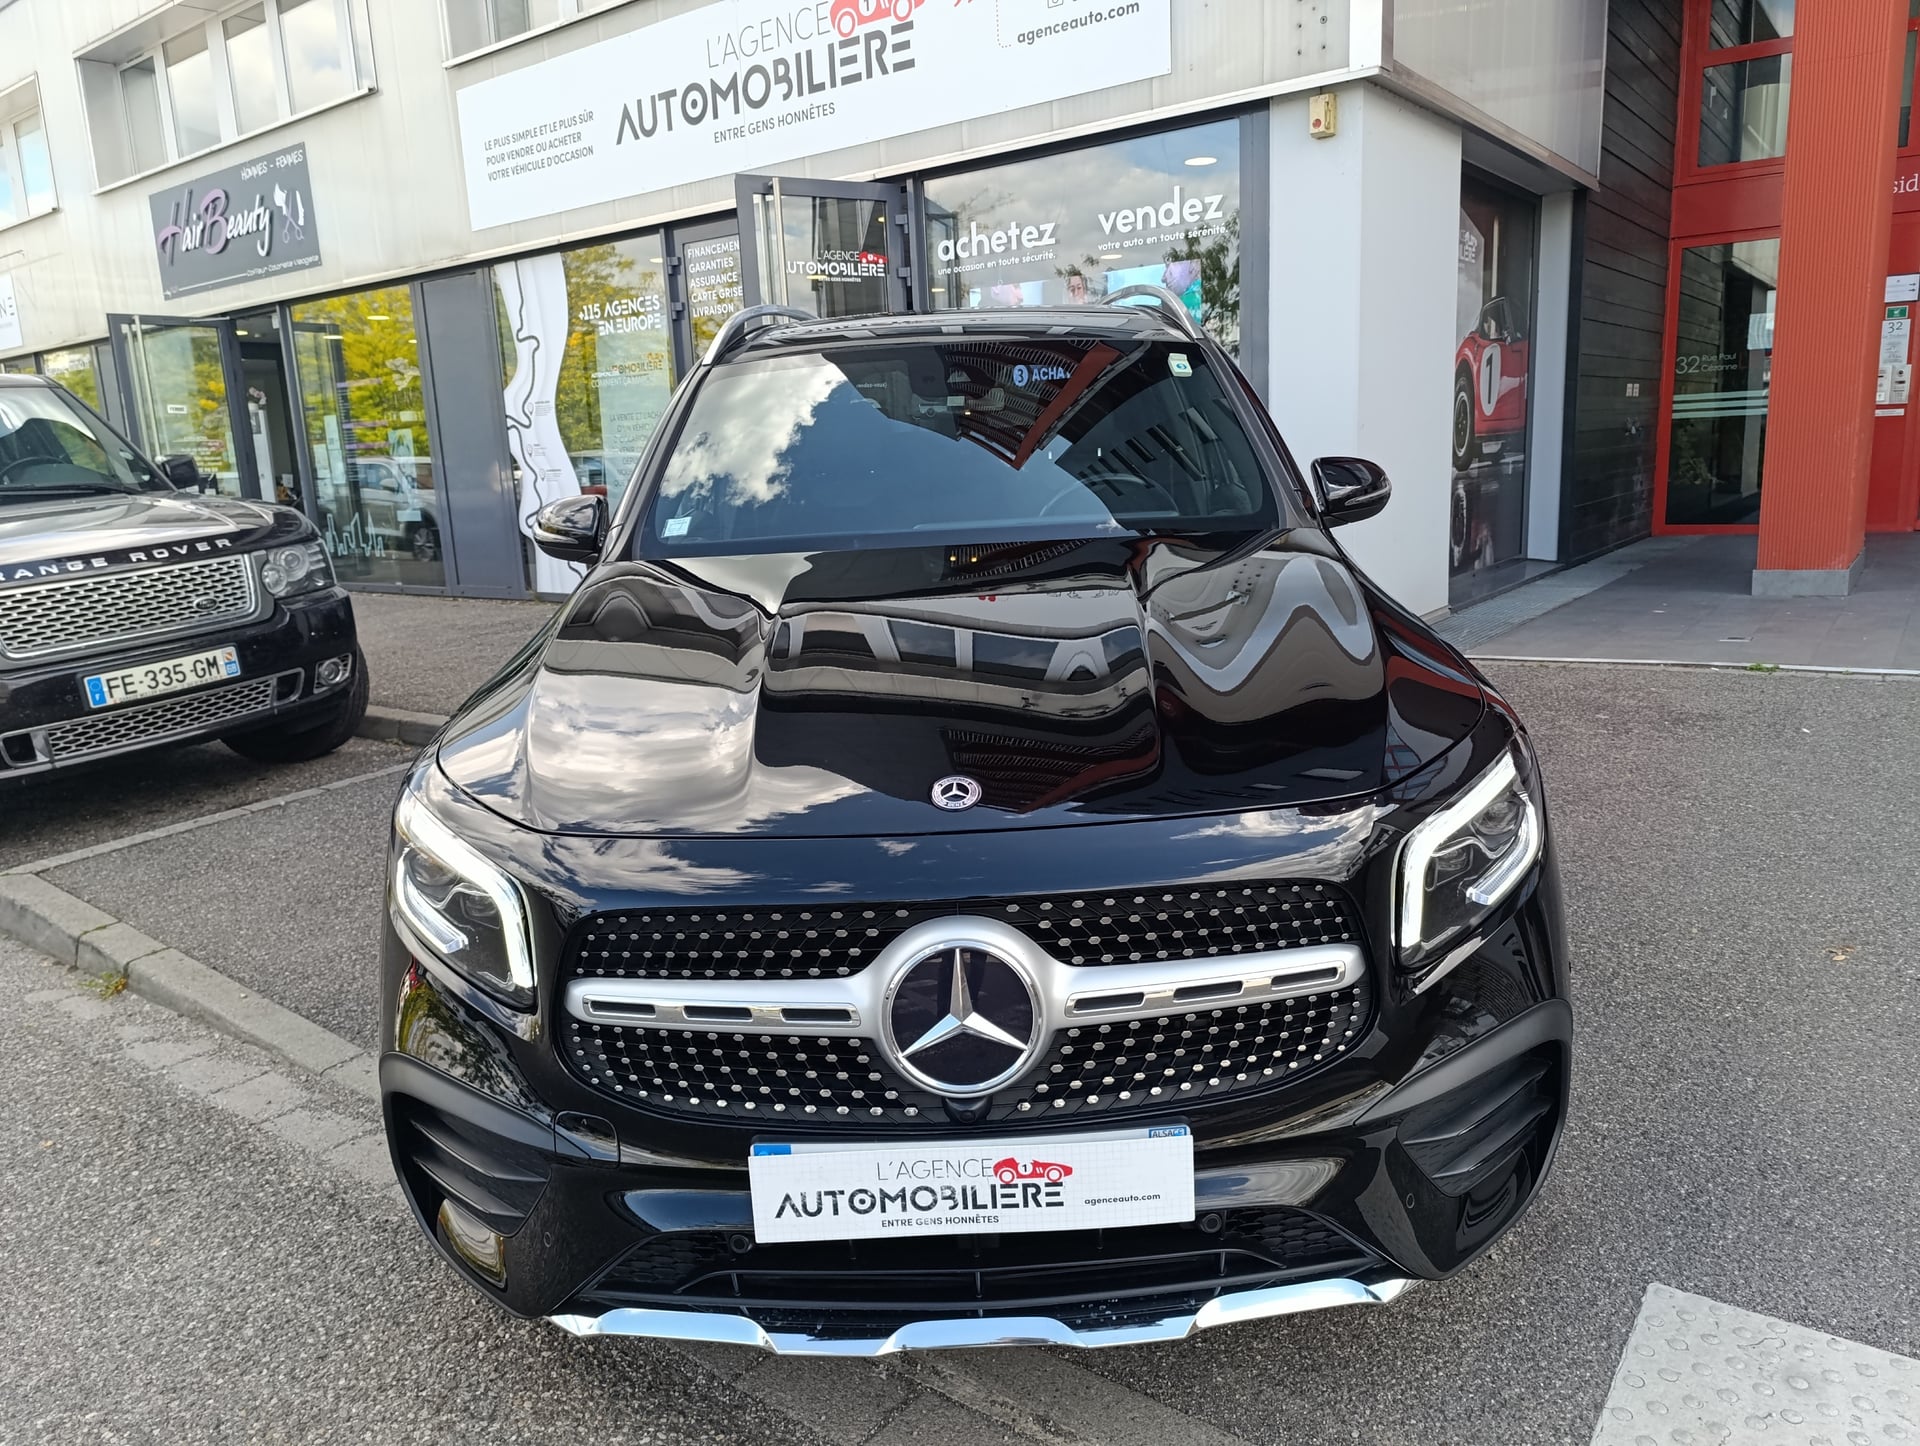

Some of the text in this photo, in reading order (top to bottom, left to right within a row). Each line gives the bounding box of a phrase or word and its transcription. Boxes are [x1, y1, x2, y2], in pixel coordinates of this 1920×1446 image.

[706, 1, 831, 68] L'AGENCE
[1017, 2, 1140, 45] agenceauto.com
[484, 109, 594, 152] LE PLUS SIMPLE ET LE PLUS SÛR
[713, 102, 836, 144] ENTRE GENS HONNÊTES
[486, 131, 582, 166] POUR VENDRE OU ACHETER
[488, 145, 594, 182] VOTRE VÉHICULE D'OCCASION
[1098, 185, 1224, 235] vendez
[937, 221, 1056, 262] achetez
[1098, 241, 1121, 251] votre
[1122, 237, 1144, 248] auto
[1146, 235, 1158, 245] en
[1160, 232, 1186, 242] toute
[688, 256, 734, 273] GARANTIES
[816, 250, 860, 262] L'AGENCE
[937, 265, 952, 275] une
[953, 260, 985, 273] occasion
[987, 259, 998, 268] en
[999, 255, 1020, 266] toute
[690, 271, 738, 288] ASSURANCE
[691, 285, 744, 303] CARTE GRISE
[578, 294, 661, 321] +115 AGENCES
[692, 303, 734, 318] LIVRAISON
[599, 313, 662, 336] EN EUROPE
[1887, 321, 1903, 334] 32
[1675, 352, 1737, 375] 32 Rue Paul
[129, 538, 232, 562] ROVER
[105, 655, 221, 699] FE-335-GM
[877, 1158, 993, 1181] L'AGENCE
[1084, 1193, 1161, 1206] agenceauto.com
[881, 1213, 1000, 1228] ENTRE GENS HONNÊTES
